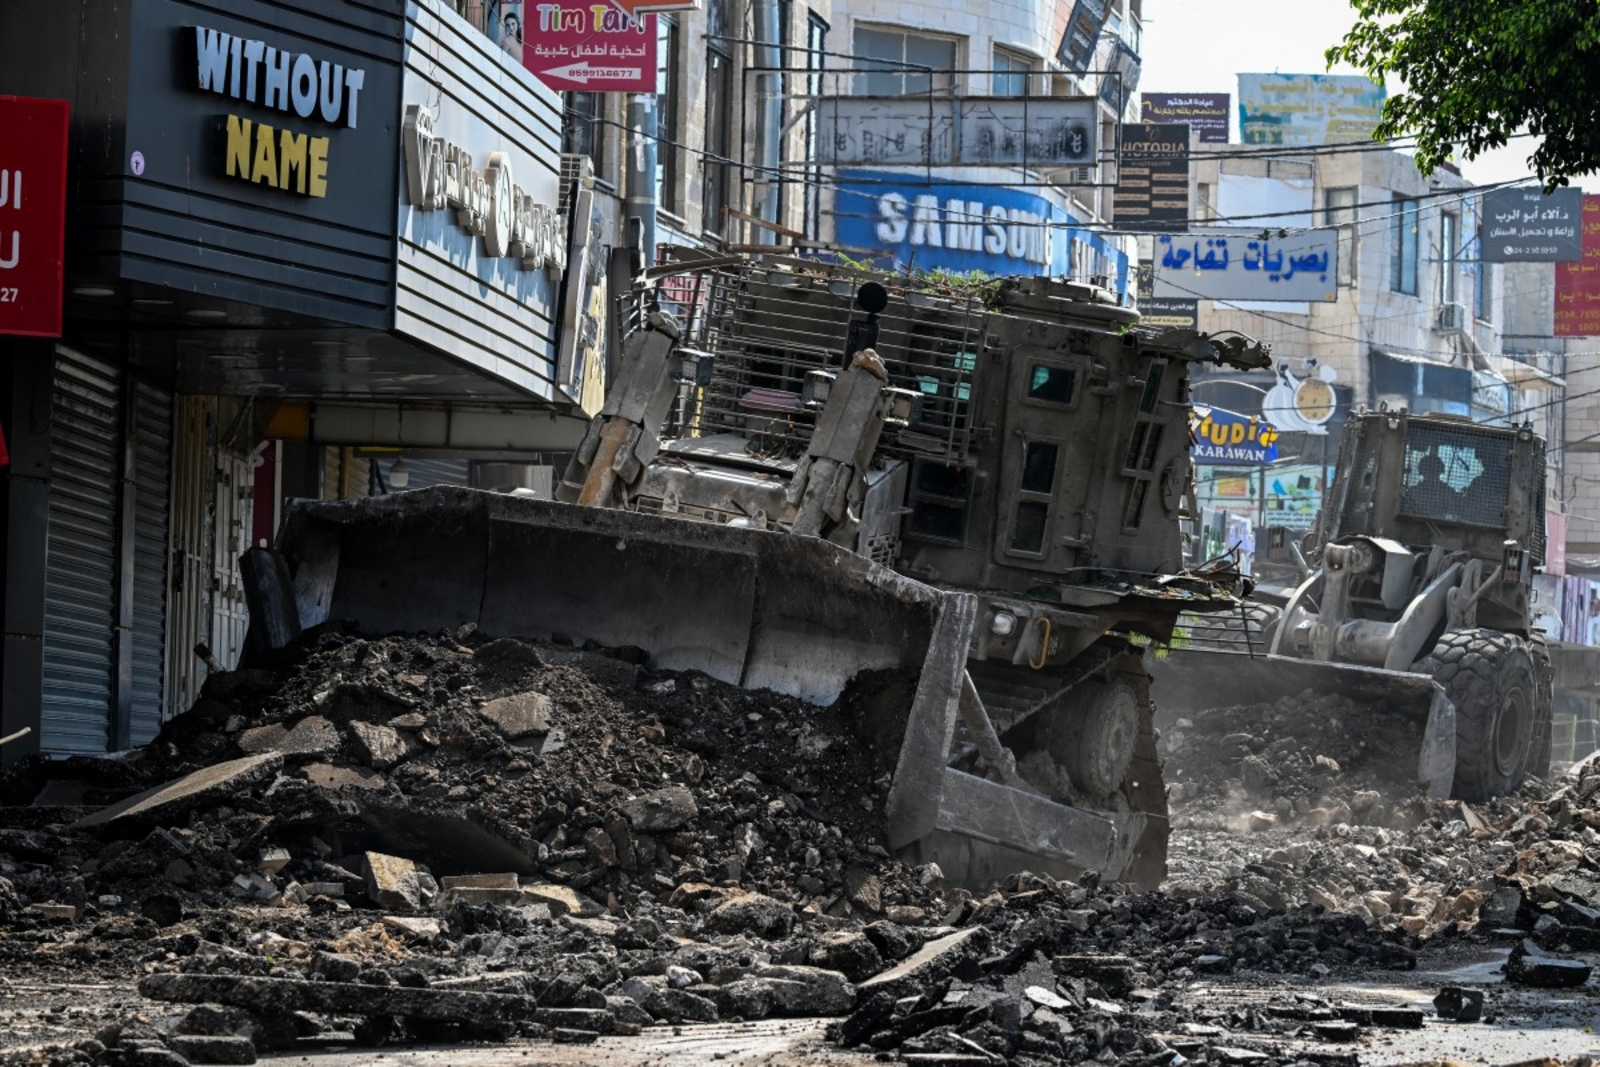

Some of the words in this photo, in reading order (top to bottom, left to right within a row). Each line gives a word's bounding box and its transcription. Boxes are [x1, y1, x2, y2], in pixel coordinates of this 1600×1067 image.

[536, 4, 586, 34] Tim
[535, 44, 569, 58] طبية
[571, 43, 608, 58] أطفال
[609, 43, 646, 59] أحذية
[195, 26, 365, 129] WITHOUT
[226, 114, 330, 198] NAME
[1496, 209, 1521, 224] الرب
[1523, 205, 1538, 223] أبو
[876, 192, 1053, 266] SAMSUNG
[1555, 226, 1575, 238] زراعة
[1160, 235, 1229, 270] تفاحة
[1243, 241, 1328, 283] بصريات
[1194, 444, 1266, 461] KARAWAN
